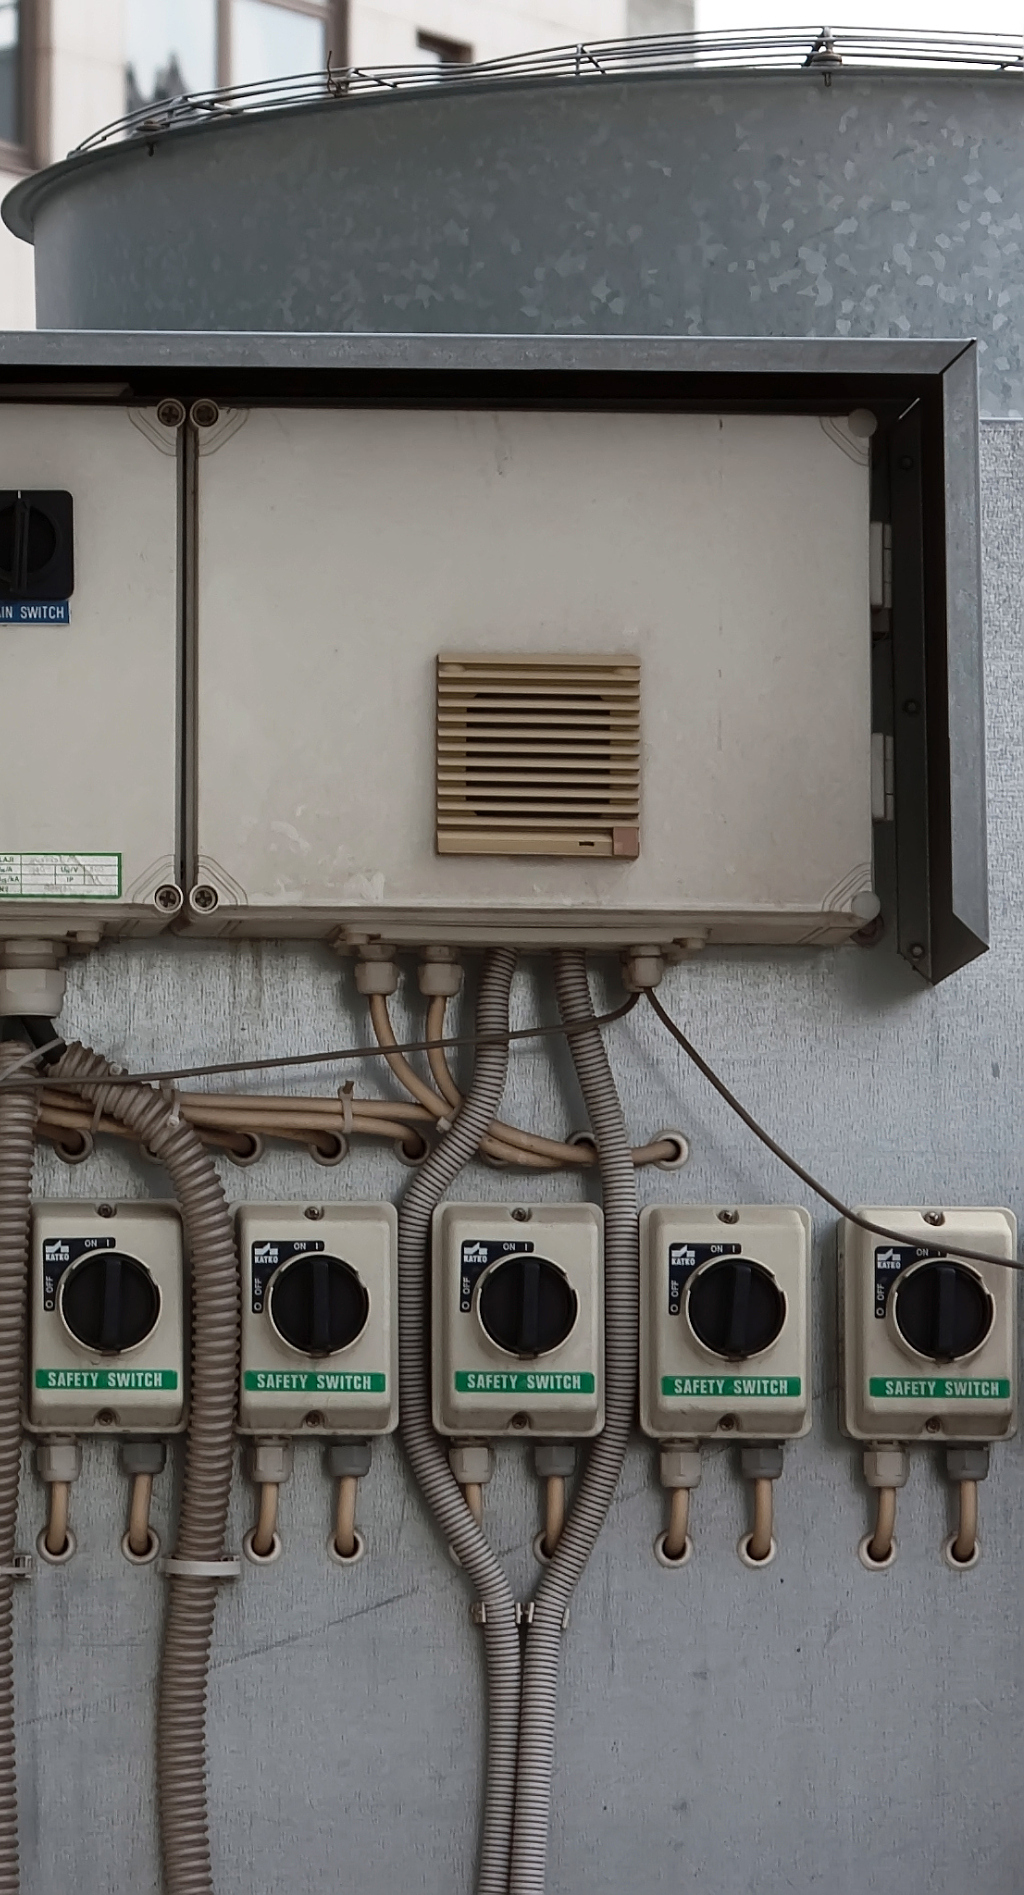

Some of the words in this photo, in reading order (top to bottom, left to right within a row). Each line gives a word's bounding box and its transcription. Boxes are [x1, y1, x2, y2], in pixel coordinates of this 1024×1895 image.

[20, 606, 64, 619] SWITCH
[84, 1239, 98, 1247] ON
[293, 1242, 307, 1250] ON
[502, 1242, 516, 1251] ON
[710, 1245, 723, 1253] ON
[45, 1253, 70, 1261] KATKO
[463, 1255, 488, 1263] KATKO
[916, 1248, 929, 1257] ON
[254, 1255, 279, 1264] KATKO
[671, 1258, 695, 1266] KATKO
[877, 1261, 901, 1269] KATKO
[45, 1275, 54, 1293] OFF
[253, 1277, 262, 1295] OFF
[462, 1277, 471, 1295] OFF
[670, 1280, 679, 1298] OFF
[876, 1283, 885, 1301] OFF
[47, 1372, 98, 1387] SAFETY
[107, 1372, 162, 1388] SWITCH
[256, 1374, 307, 1389] SAFETY
[316, 1374, 372, 1390] SWITCH
[467, 1374, 518, 1389] SAFETY
[526, 1373, 581, 1390] SWITCH
[674, 1379, 725, 1394] SAFETY
[733, 1379, 788, 1395] SWITCH
[885, 1381, 936, 1396] SAFETY
[944, 1381, 1000, 1396] SWITCH
